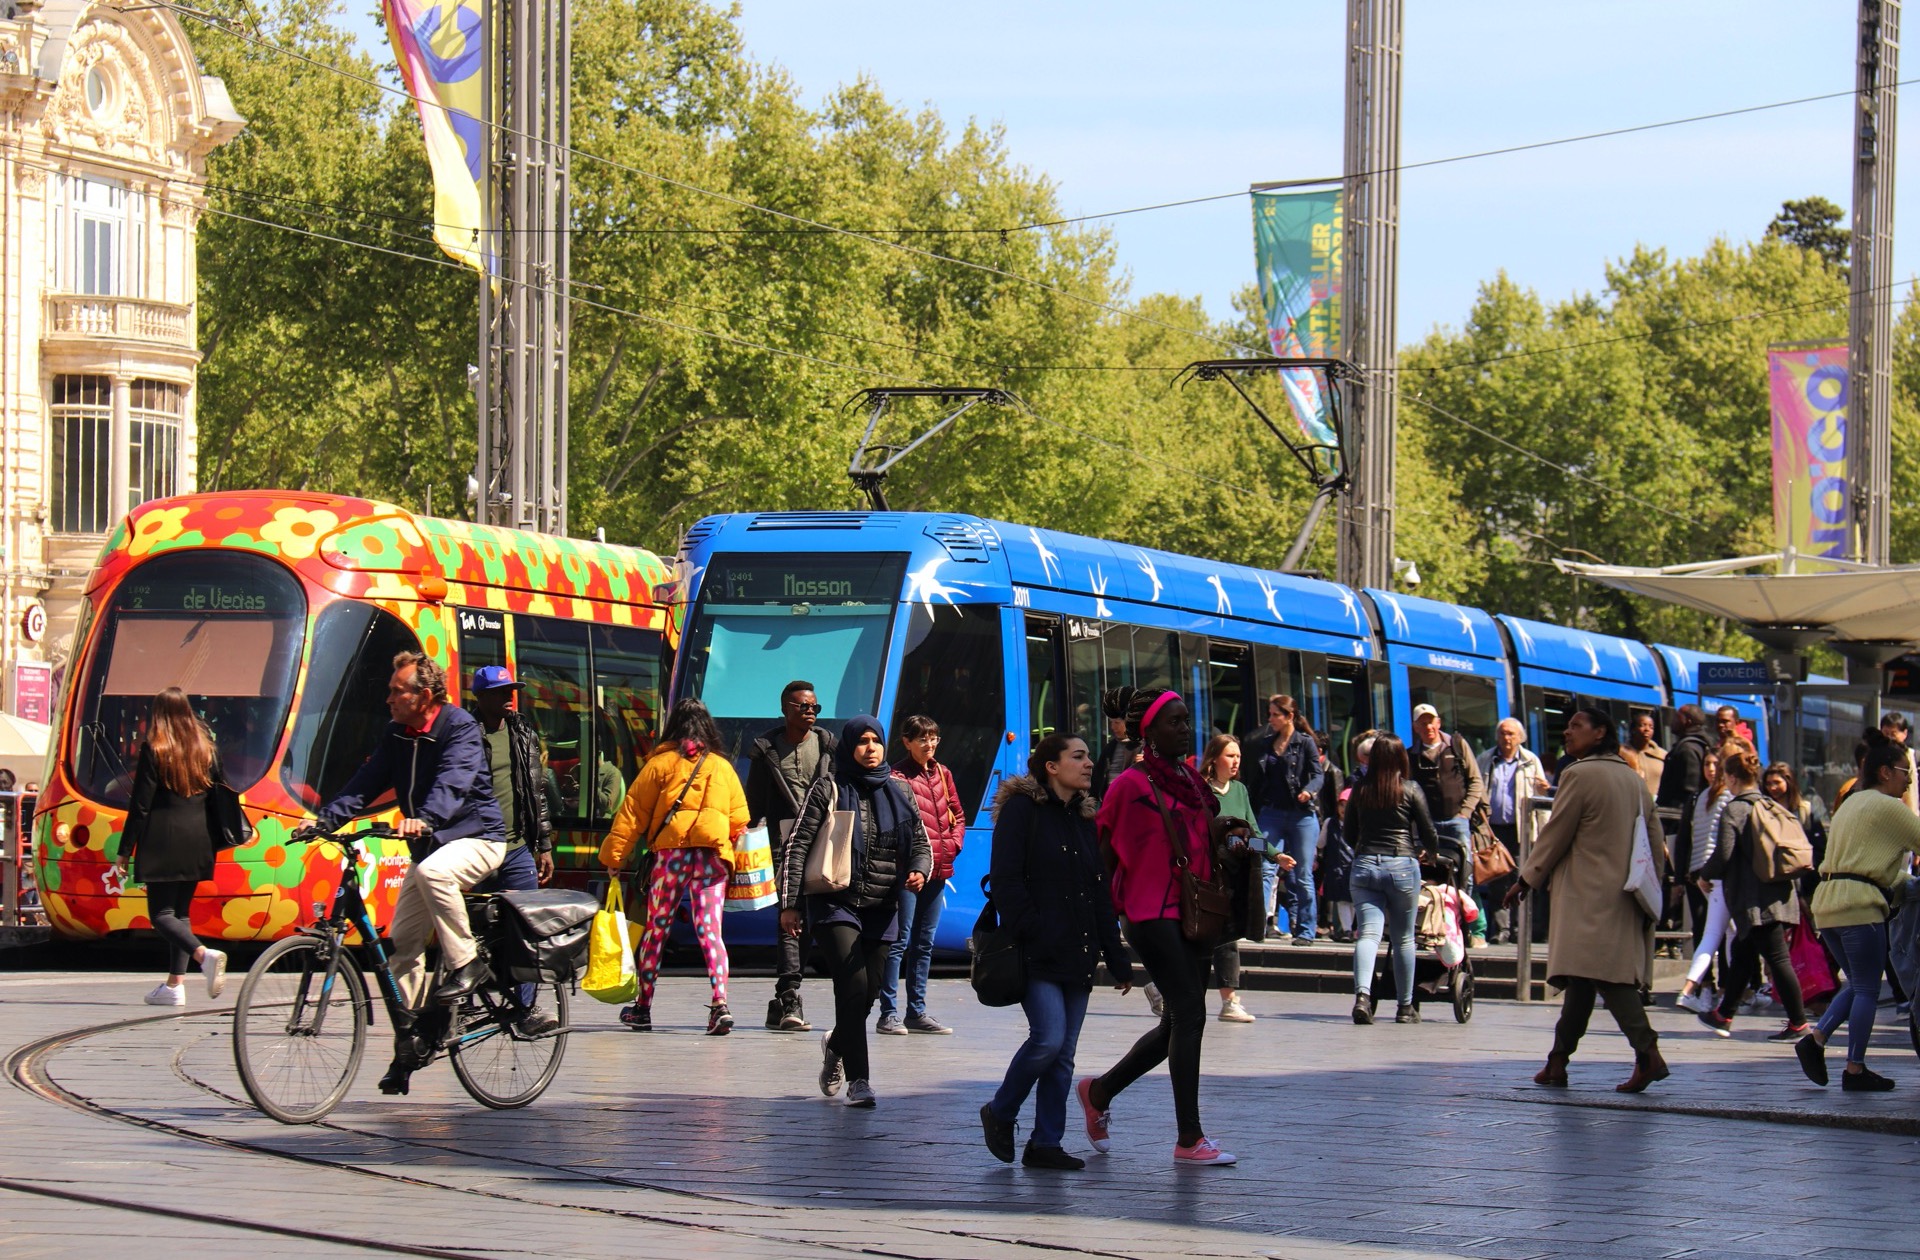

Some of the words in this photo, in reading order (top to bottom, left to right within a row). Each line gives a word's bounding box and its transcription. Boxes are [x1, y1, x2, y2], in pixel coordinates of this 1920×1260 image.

[731, 572, 753, 581] 2401
[784, 574, 852, 596] Mosson
[183, 587, 206, 610] de
[1012, 586, 1031, 607] 2011
[32, 613, 43, 632] G
[1708, 667, 1766, 679] COMEDIE
[736, 851, 759, 871] SAC
[735, 873, 761, 884] PORTER
[728, 885, 763, 898] COURSES
